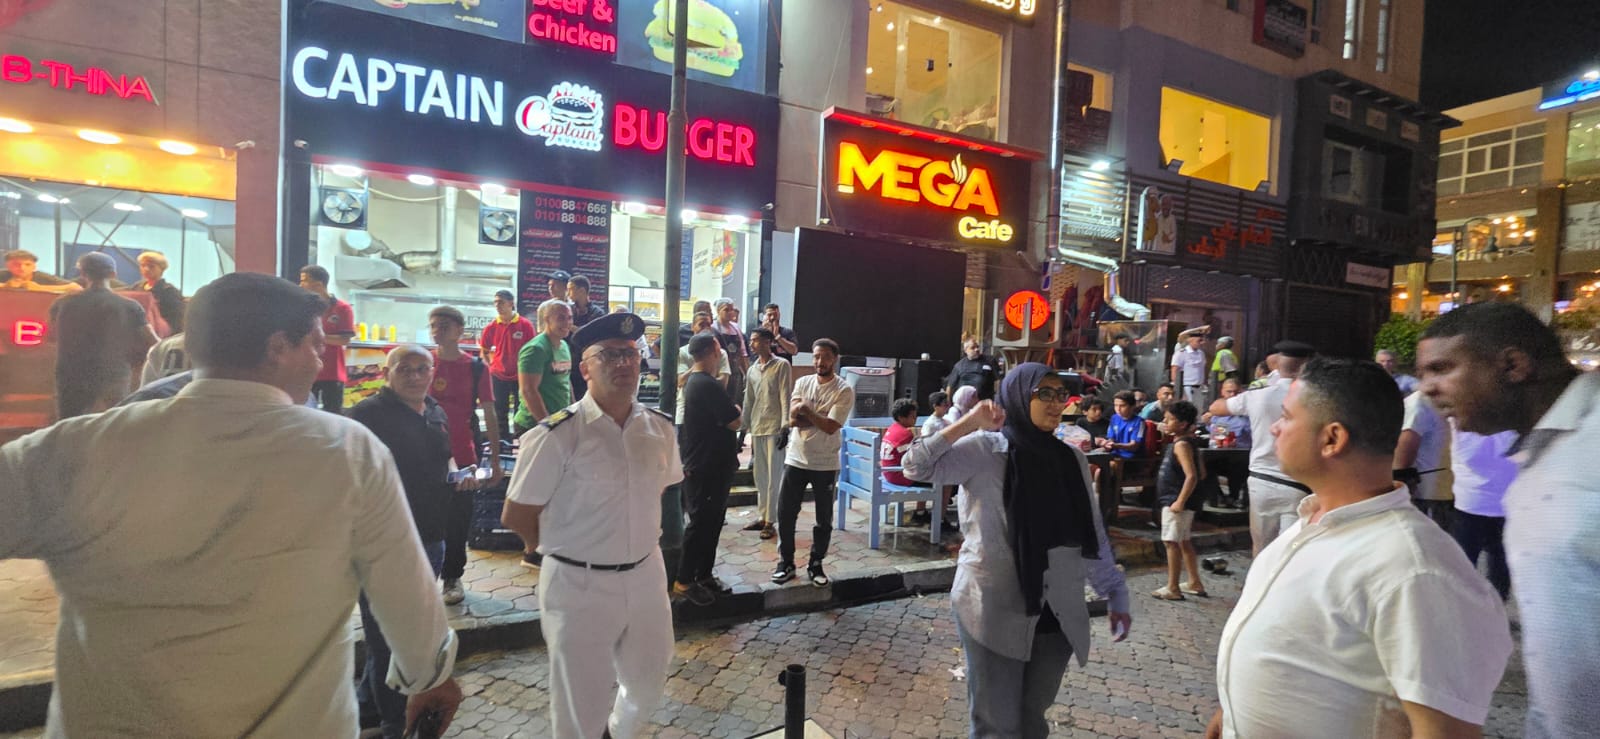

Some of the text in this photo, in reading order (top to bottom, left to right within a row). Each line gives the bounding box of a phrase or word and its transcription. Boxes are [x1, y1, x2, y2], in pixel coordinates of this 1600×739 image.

[533, 0, 613, 23] eef &
[528, 13, 616, 53] Chicken
[2, 54, 157, 103] B-THINA
[292, 46, 504, 126] CAPTAIN
[521, 99, 597, 142] Captain
[614, 104, 754, 167] BUGER
[838, 141, 999, 216] MEGA
[535, 197, 607, 214] 01008847666
[958, 216, 1013, 241] Cafe
[1008, 302, 1044, 316] MA
